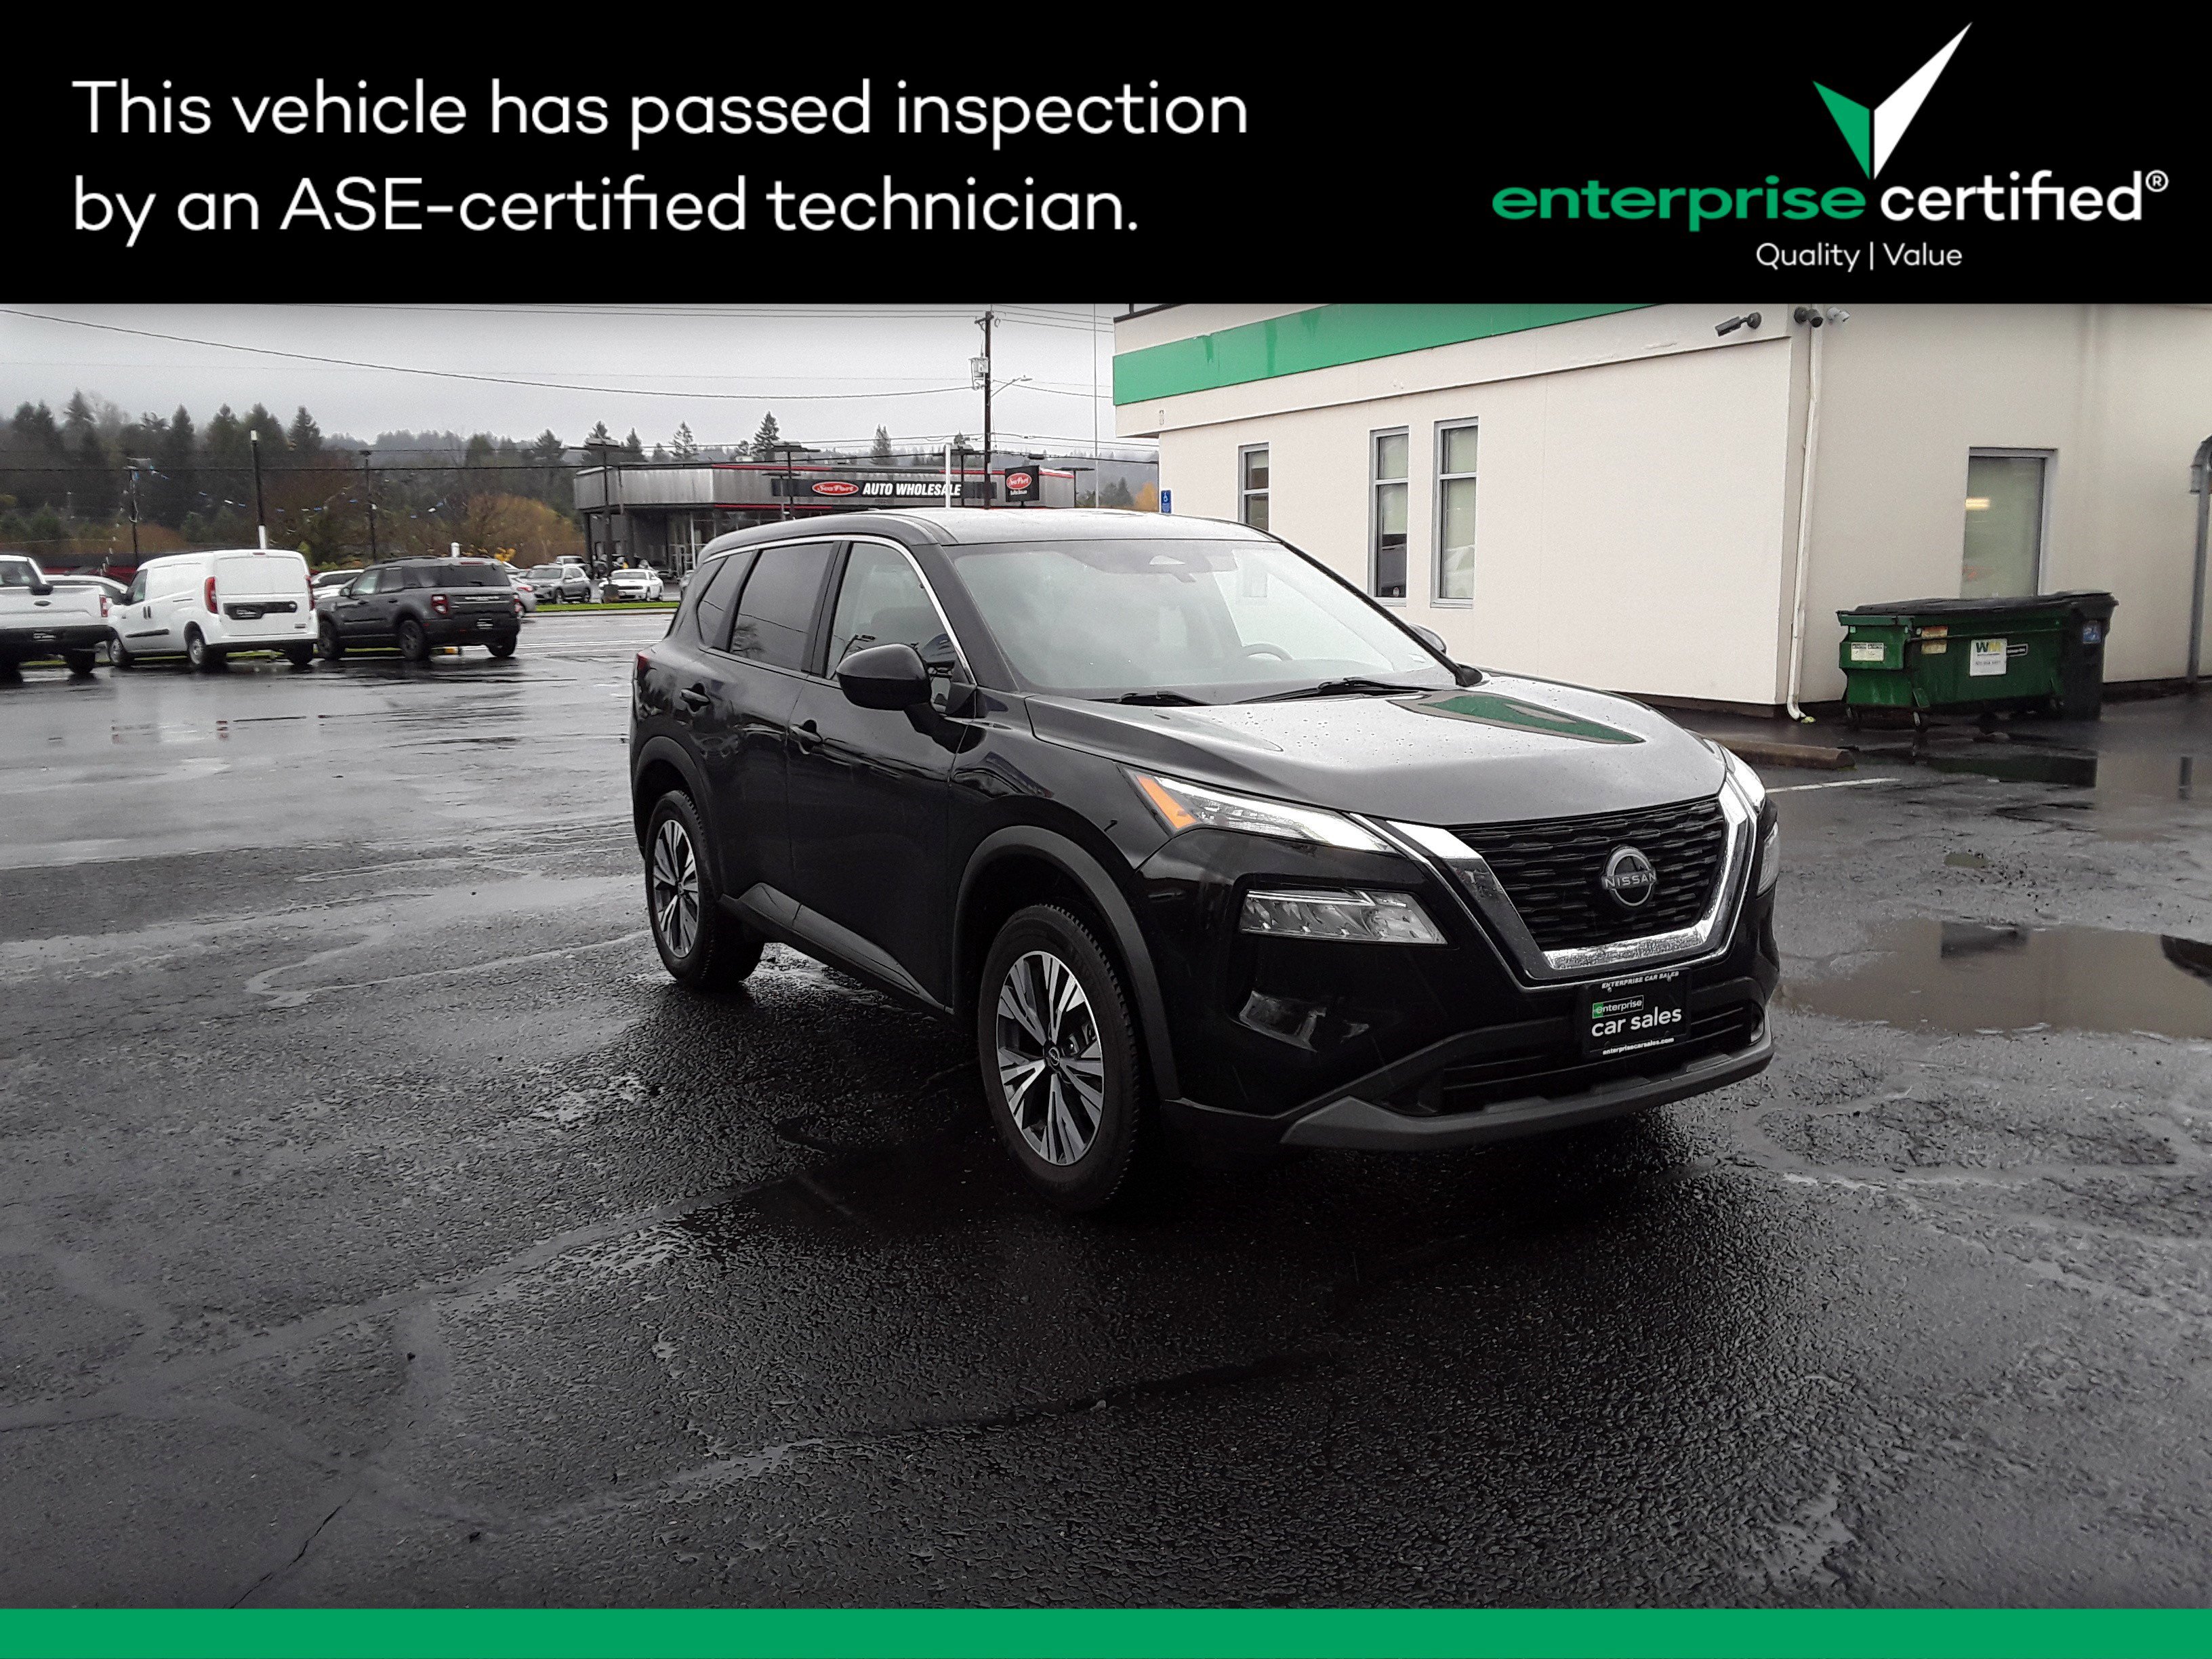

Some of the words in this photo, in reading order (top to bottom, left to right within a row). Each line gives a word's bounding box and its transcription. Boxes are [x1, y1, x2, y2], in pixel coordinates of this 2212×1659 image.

[862, 483, 893, 495] AUTO
[896, 483, 962, 496] WHOLESALE
[1976, 642, 2001, 653] WM
[1605, 872, 1656, 888] NISSAN
[1645, 974, 1658, 982] CAR
[1595, 1000, 1643, 1014] enterprise
[1591, 1018, 1626, 1037] car
[1630, 1006, 1682, 1030] sales
